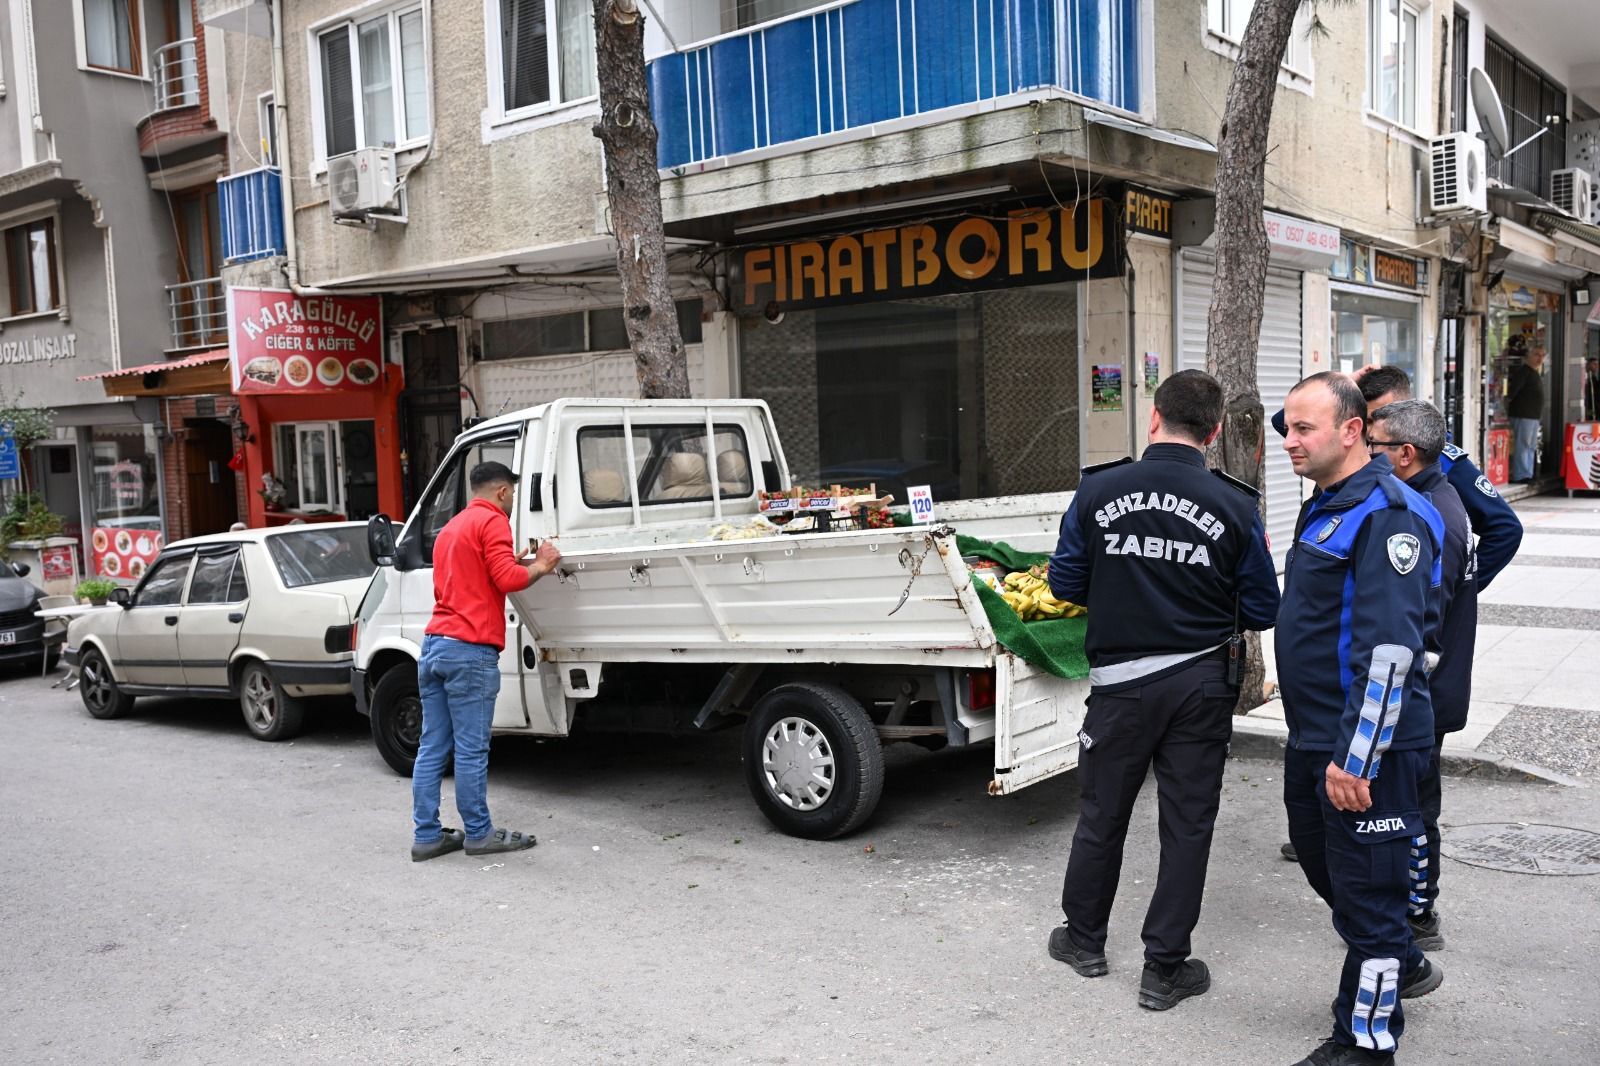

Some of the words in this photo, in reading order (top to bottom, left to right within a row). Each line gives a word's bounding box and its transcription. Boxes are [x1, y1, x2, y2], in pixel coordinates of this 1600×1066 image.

[1126, 190, 1171, 233] FIRAT
[1265, 221, 1280, 237] RET
[241, 297, 376, 343] KARAGÜLLÜ
[285, 324, 304, 334] 238
[307, 325, 319, 334] 19
[323, 325, 335, 335] 15
[33, 334, 77, 366] İNŞAAT
[265, 333, 303, 351] CİĞER
[305, 338, 315, 351] &
[317, 335, 356, 351] KÖFTE
[911, 497, 932, 514] 120
[1095, 491, 1225, 541] ŞEHZADELER
[1104, 533, 1210, 567] ZABITA
[1355, 817, 1407, 833] ZABITA
